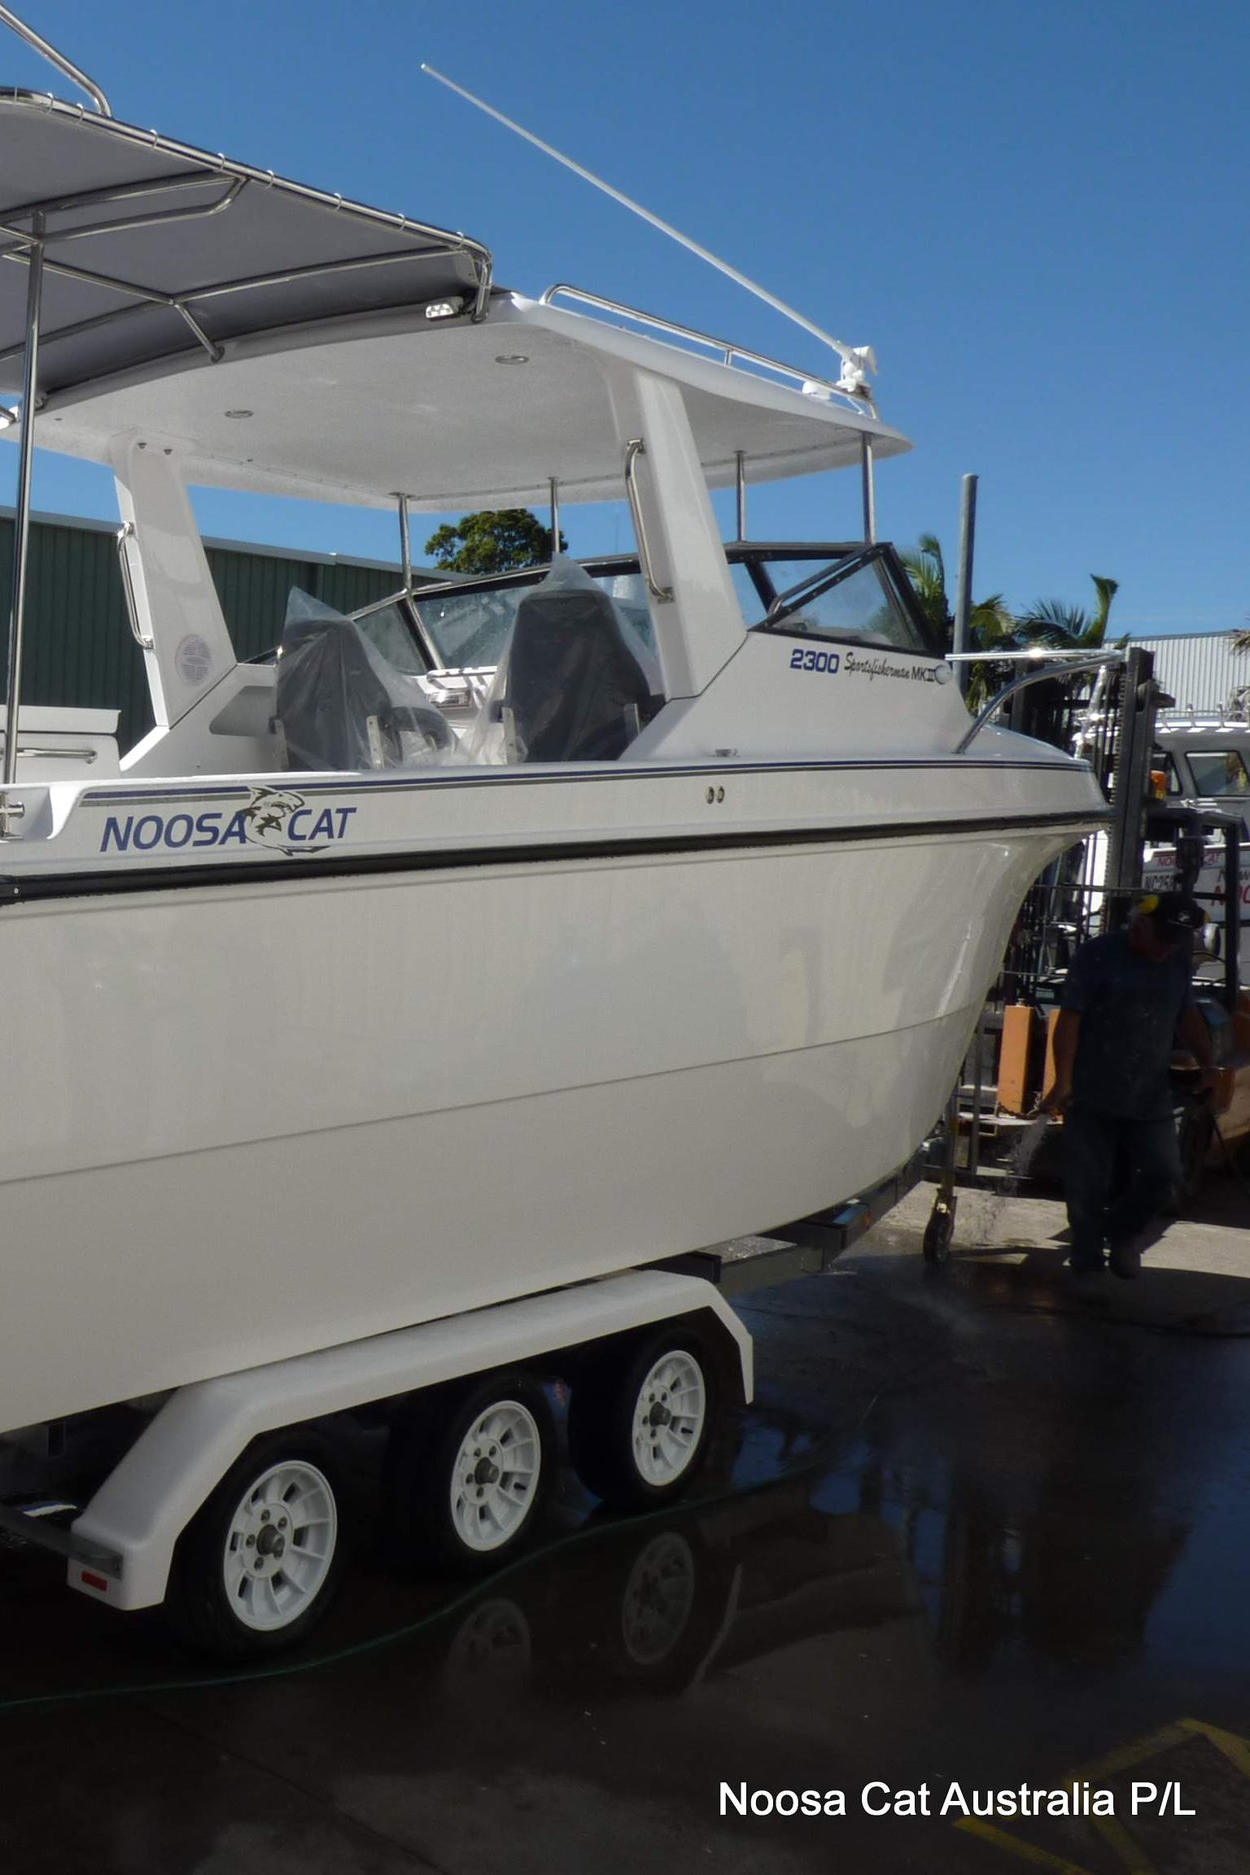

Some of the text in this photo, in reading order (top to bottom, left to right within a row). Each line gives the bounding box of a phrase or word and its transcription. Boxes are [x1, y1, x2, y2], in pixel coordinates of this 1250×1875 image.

[790, 649, 840, 674] 2300
[100, 807, 357, 852] NOOSA CAT
